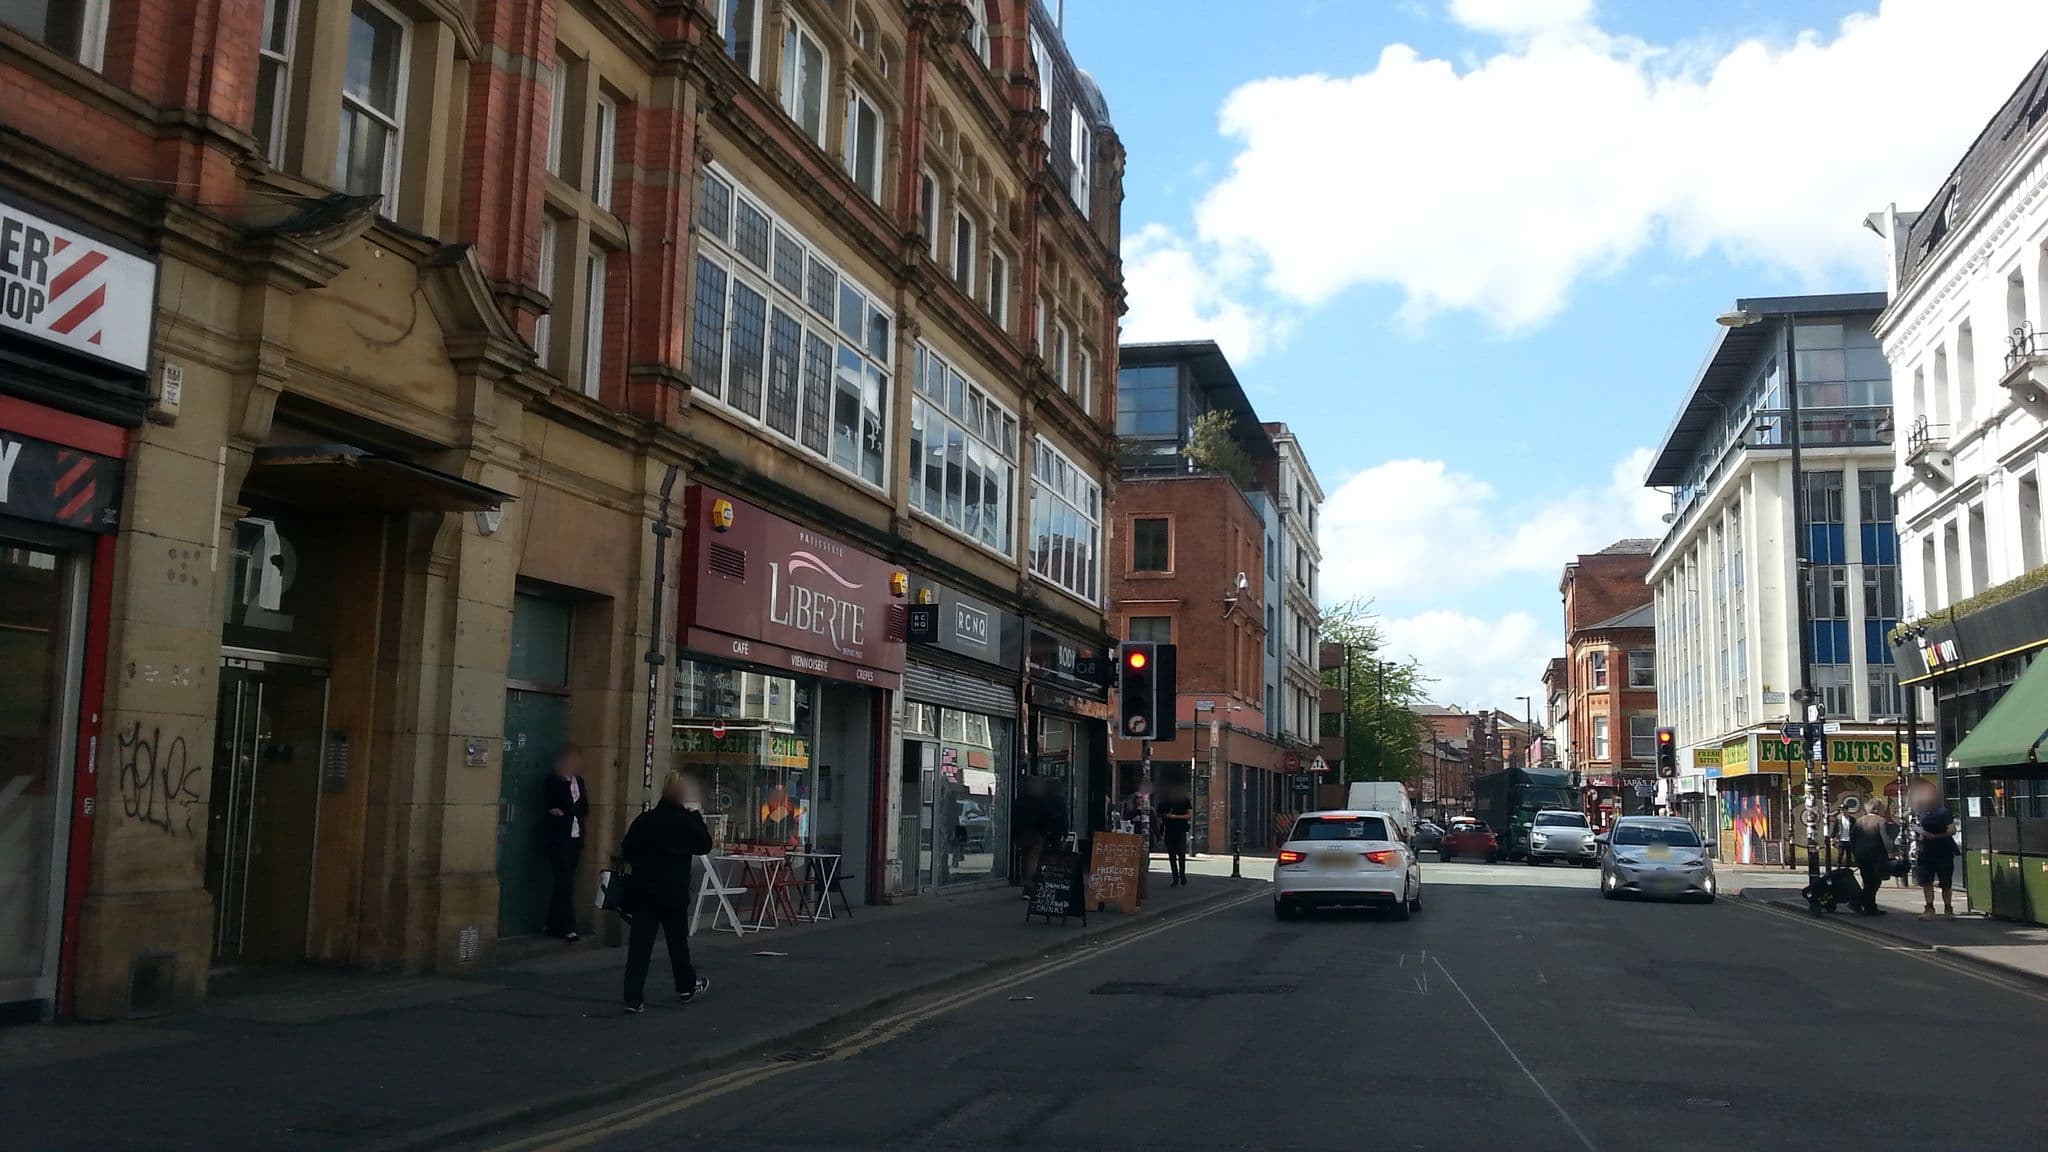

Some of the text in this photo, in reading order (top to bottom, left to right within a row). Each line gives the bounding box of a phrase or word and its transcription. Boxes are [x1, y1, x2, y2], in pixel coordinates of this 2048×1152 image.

[800, 532, 844, 557] PATISSERIE
[958, 611, 986, 637] RCNQ
[791, 655, 829, 673] VIENNOISERIE
[1058, 645, 1076, 669] BODY
[1832, 740, 1894, 763] BITES
[1095, 843, 1138, 858] BARBER
